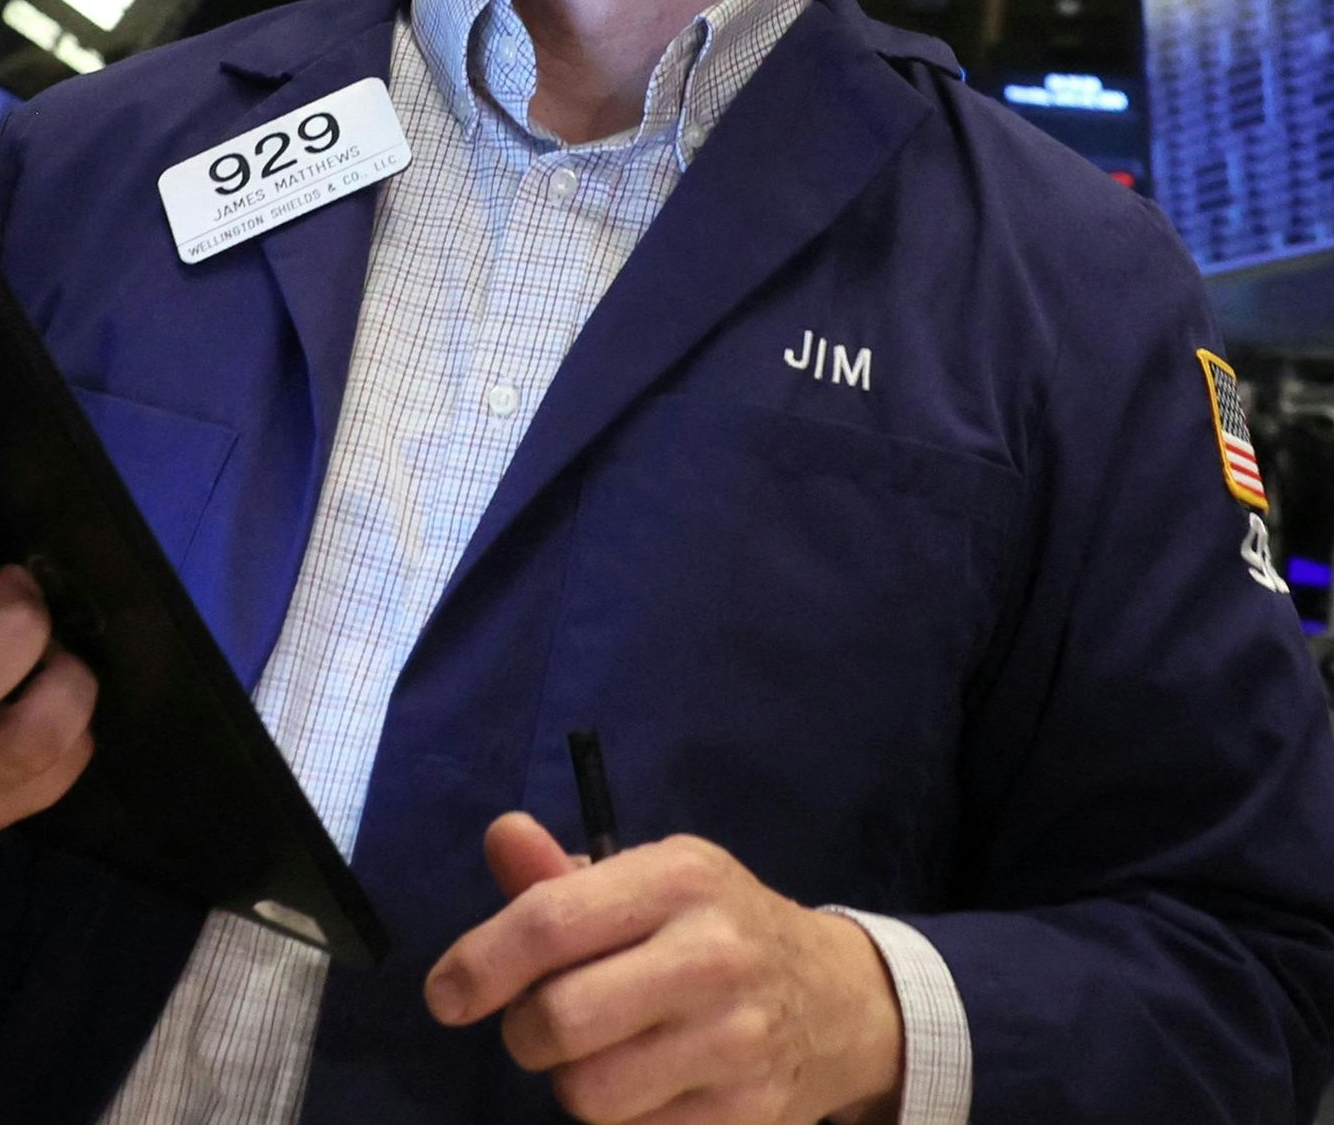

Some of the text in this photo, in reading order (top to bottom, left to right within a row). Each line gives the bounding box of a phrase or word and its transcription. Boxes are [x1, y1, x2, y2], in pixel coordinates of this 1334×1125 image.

[208, 111, 341, 196] 929
[213, 145, 361, 222] JAMES MATTHEWS
[188, 216, 265, 257] WELLINGTON
[270, 189, 322, 219] SHIELDS
[373, 154, 397, 173] LLC
[783, 329, 872, 391] JIM
